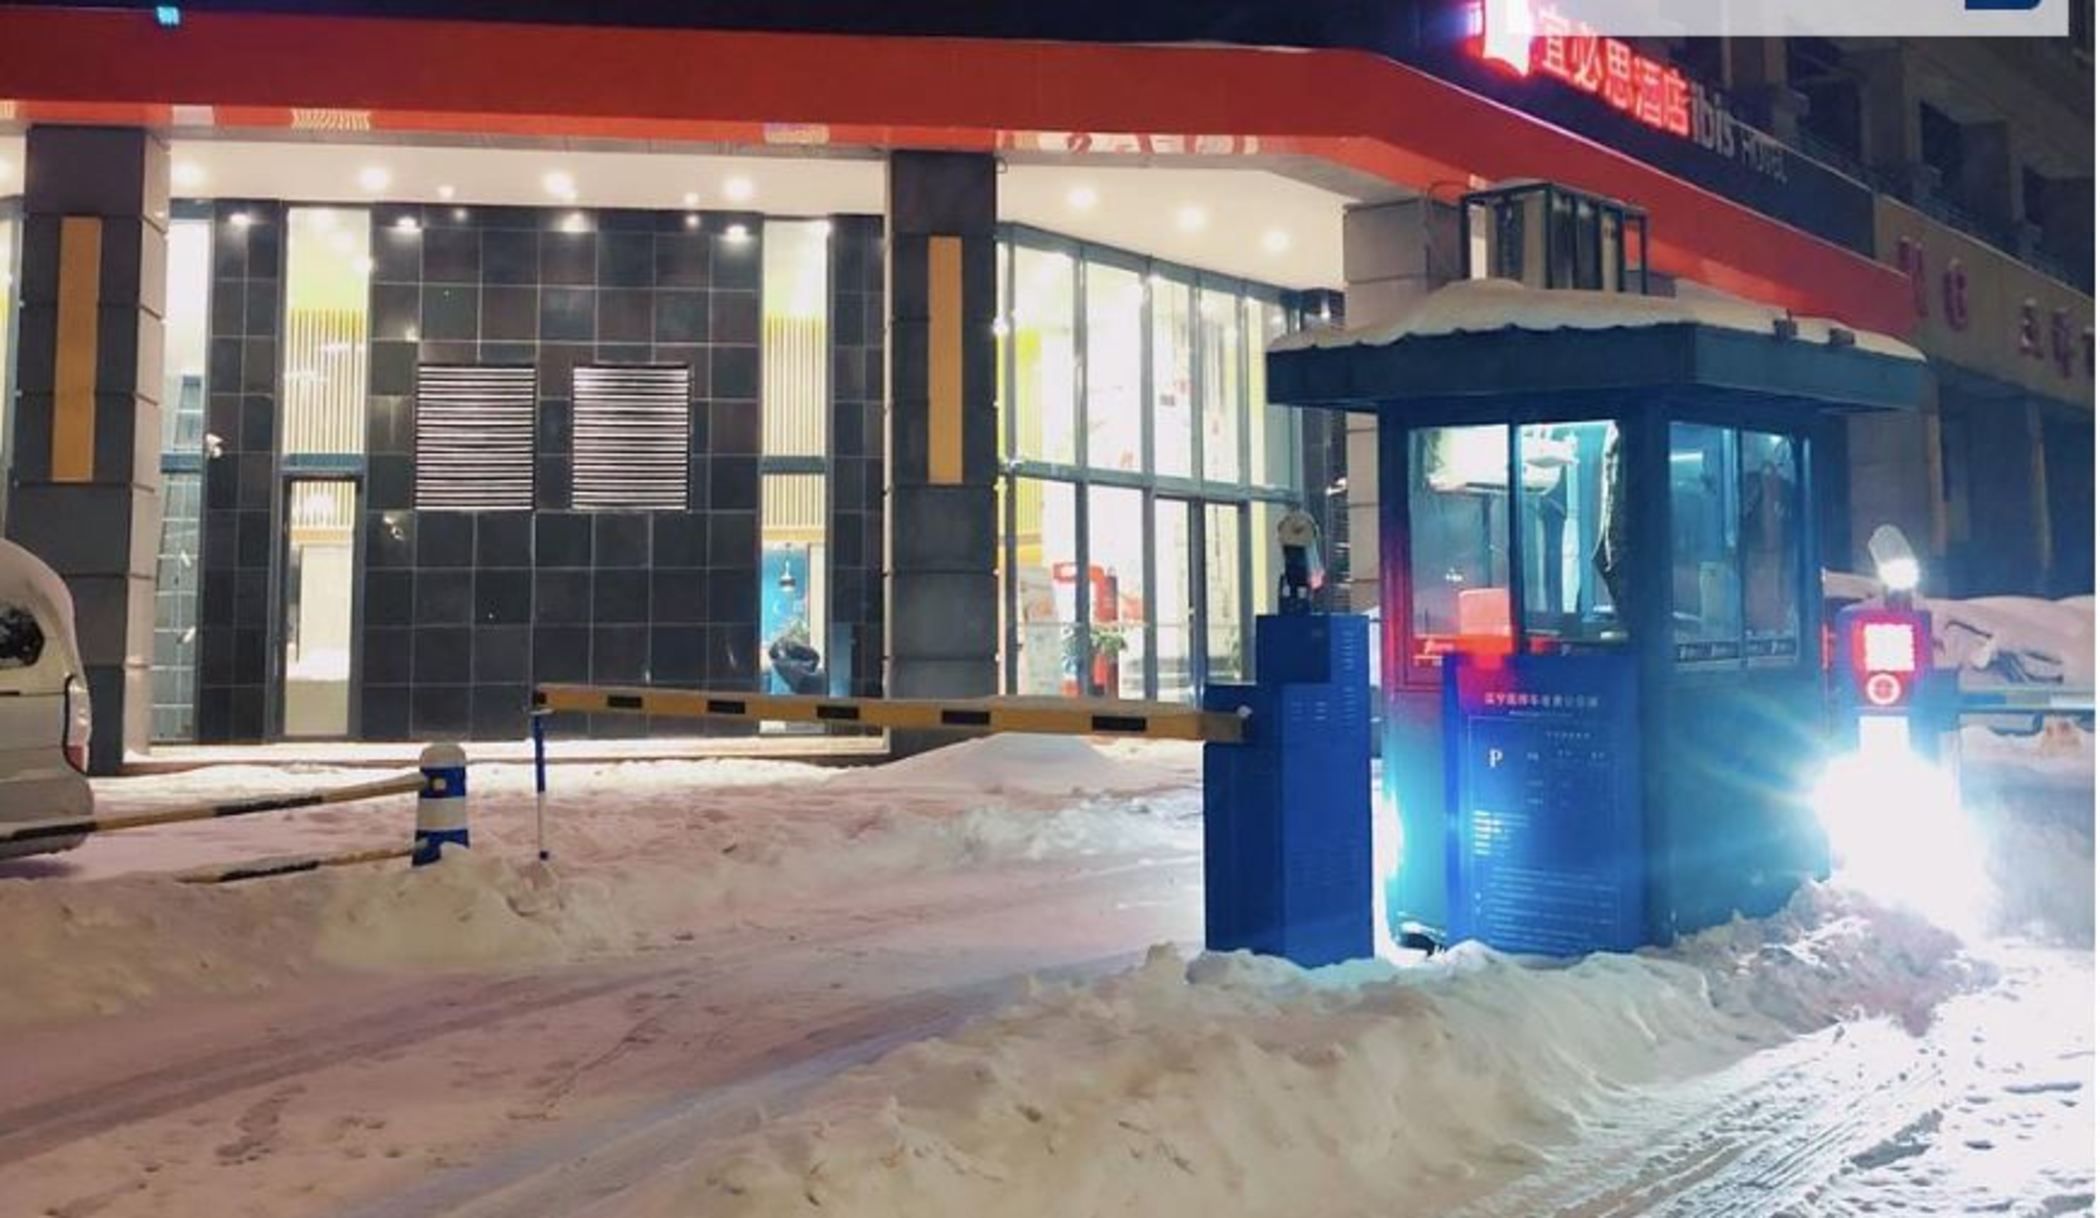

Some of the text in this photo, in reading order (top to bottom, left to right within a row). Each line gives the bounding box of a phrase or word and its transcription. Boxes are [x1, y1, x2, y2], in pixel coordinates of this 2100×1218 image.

[1537, 4, 1691, 137] 宜必思酒店
[1690, 81, 1788, 184] ibis HOTEL
[1488, 748, 1504, 768] P
